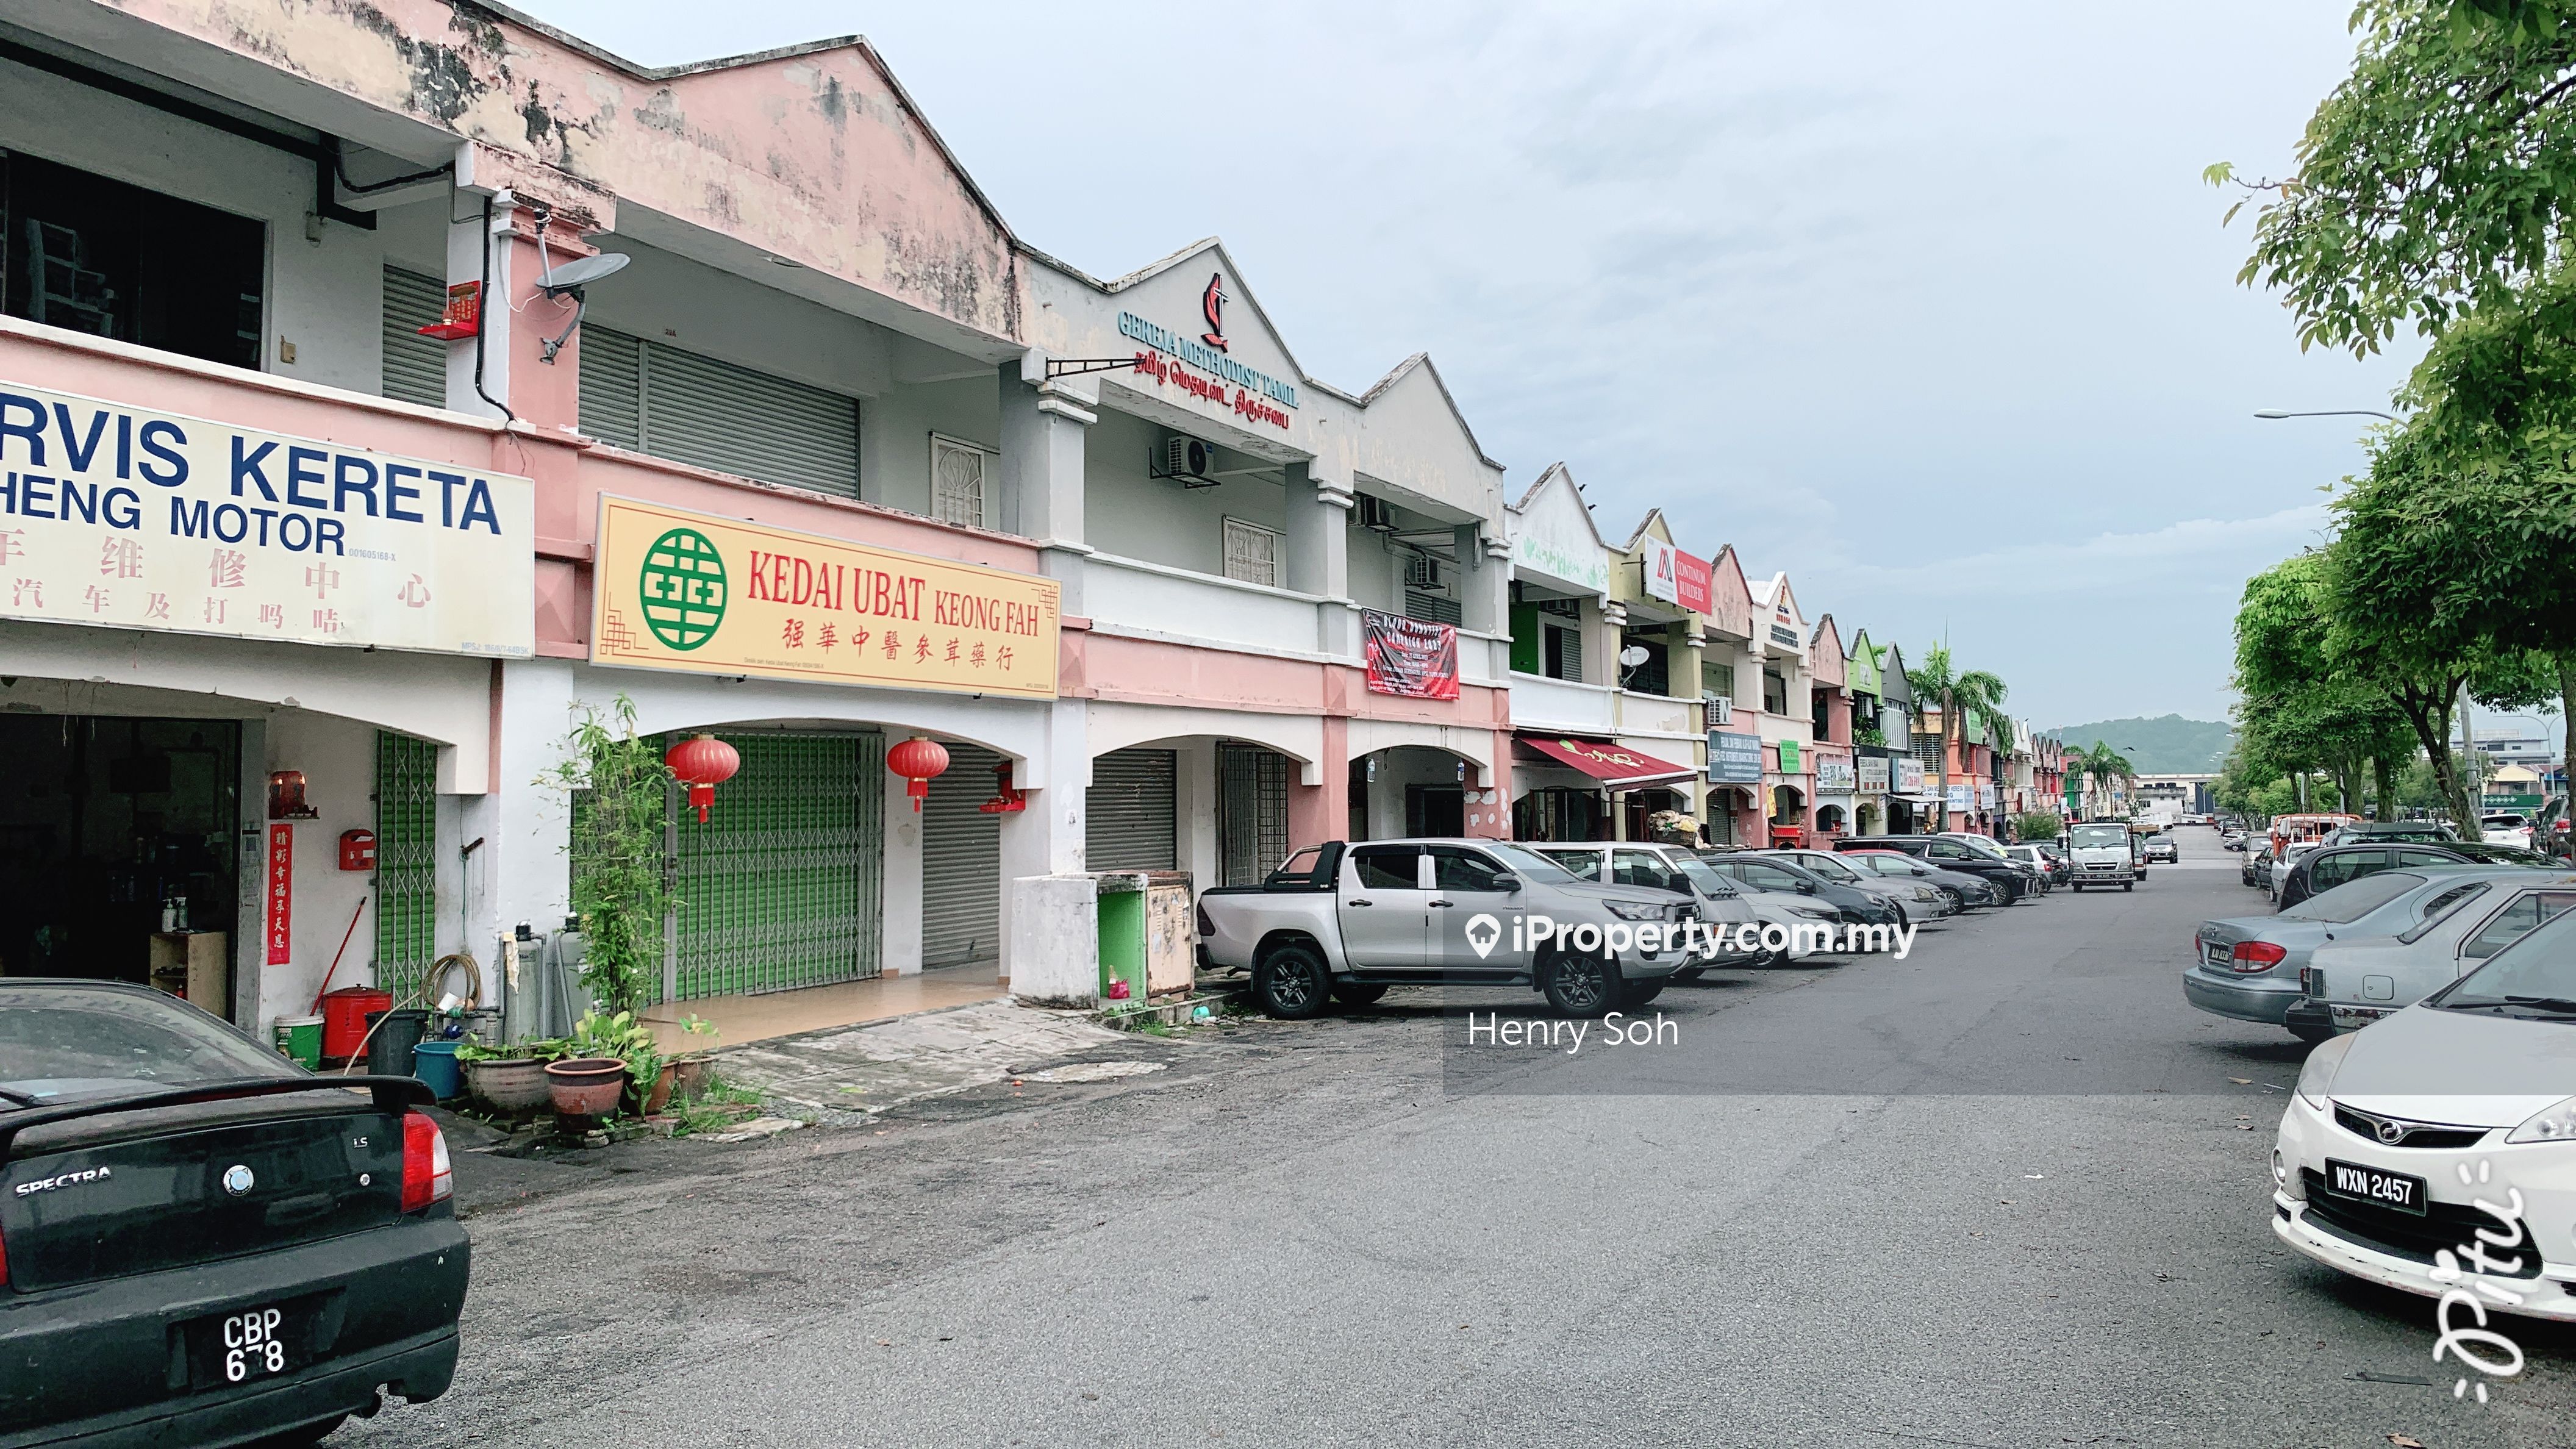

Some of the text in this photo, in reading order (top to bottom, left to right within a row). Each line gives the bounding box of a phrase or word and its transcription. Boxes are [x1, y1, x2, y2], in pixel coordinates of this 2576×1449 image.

[1118, 311, 1299, 409] GEREJA METHODIST TAMIL
[0, 392, 502, 535] RVIS KERETA
[171, 496, 345, 556] MOTOR
[349, 548, 396, 561] 001605168-X
[748, 550, 1039, 637] KEDAI UBAT KEONG FAH
[1679, 580, 1704, 602] BUILDERS
[1384, 615, 1406, 631] BLOOD
[1387, 631, 1421, 649] CAMPAIGN
[16, 1166, 112, 1198] SPECTRA
[2336, 1165, 2413, 1205] WXN 2457
[224, 1308, 281, 1348] CBP
